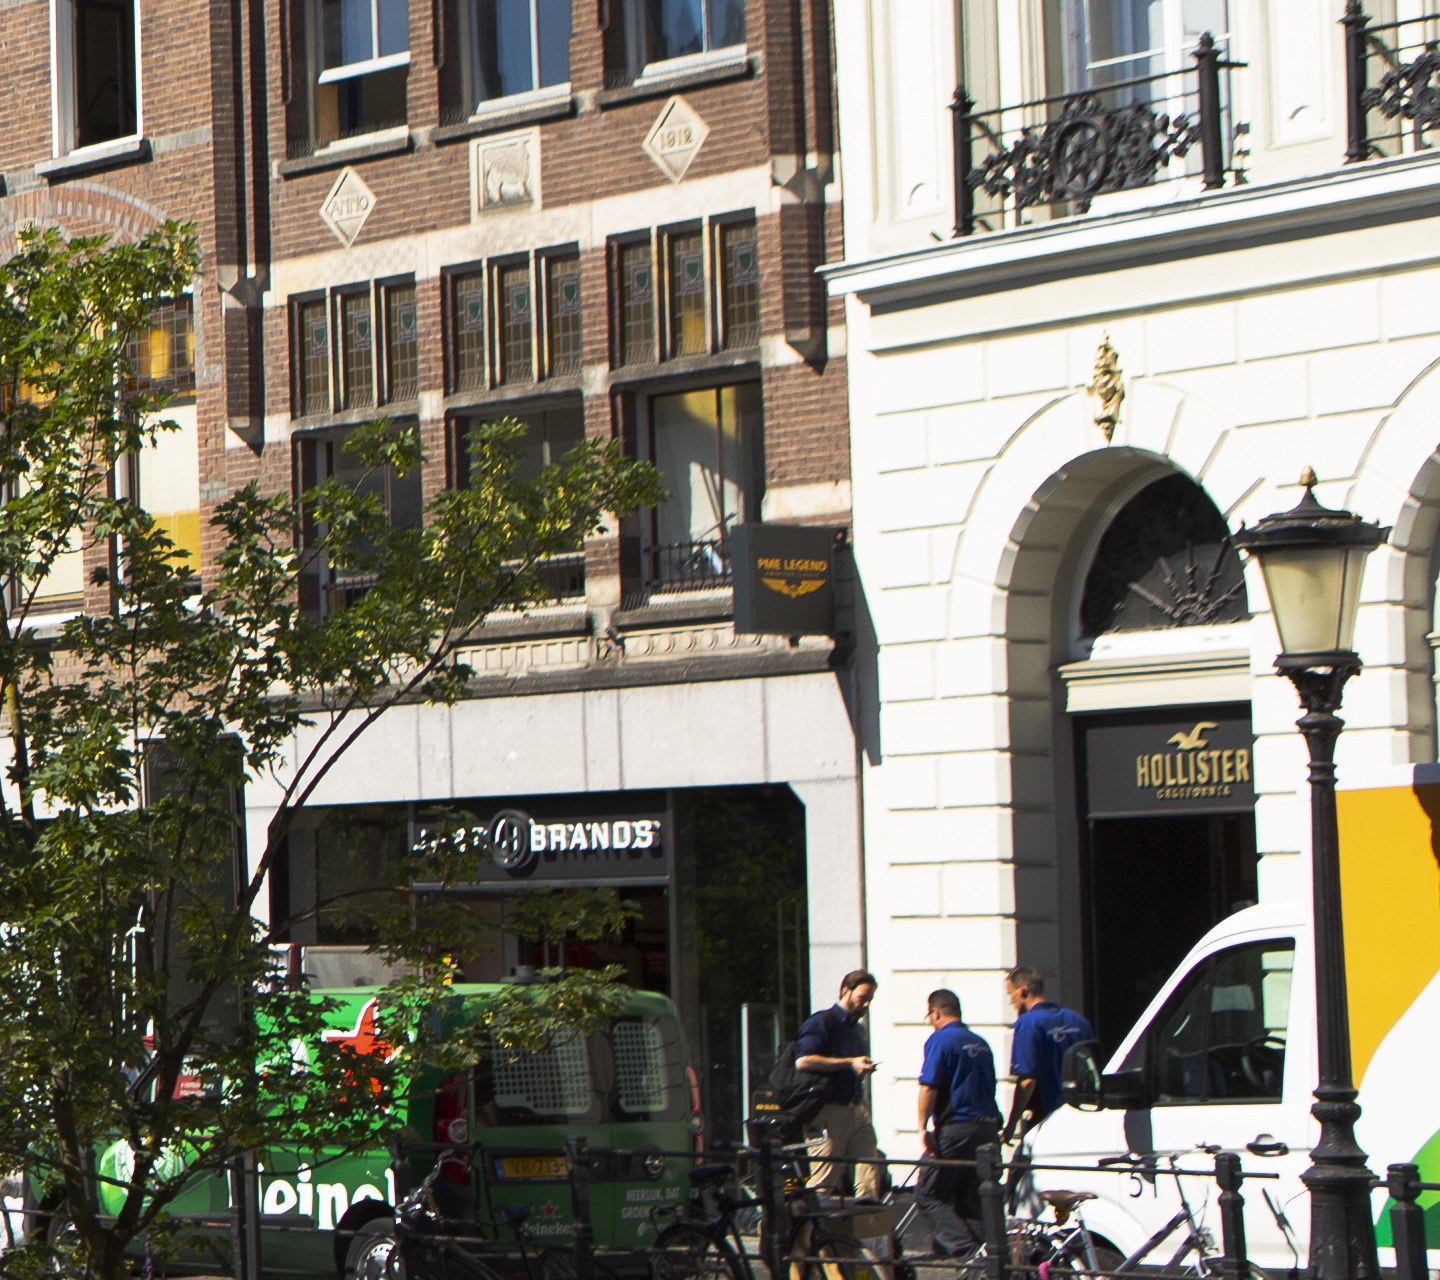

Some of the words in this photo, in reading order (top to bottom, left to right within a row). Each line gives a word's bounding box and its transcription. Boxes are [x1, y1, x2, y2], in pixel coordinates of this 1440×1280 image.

[658, 127, 694, 152] 1912
[330, 195, 370, 216] ANNO
[757, 557, 781, 570] PME
[783, 559, 828, 572] LEGEND
[1135, 748, 1250, 788] HOLLISTER
[1156, 785, 1232, 799] CALIFORNIA
